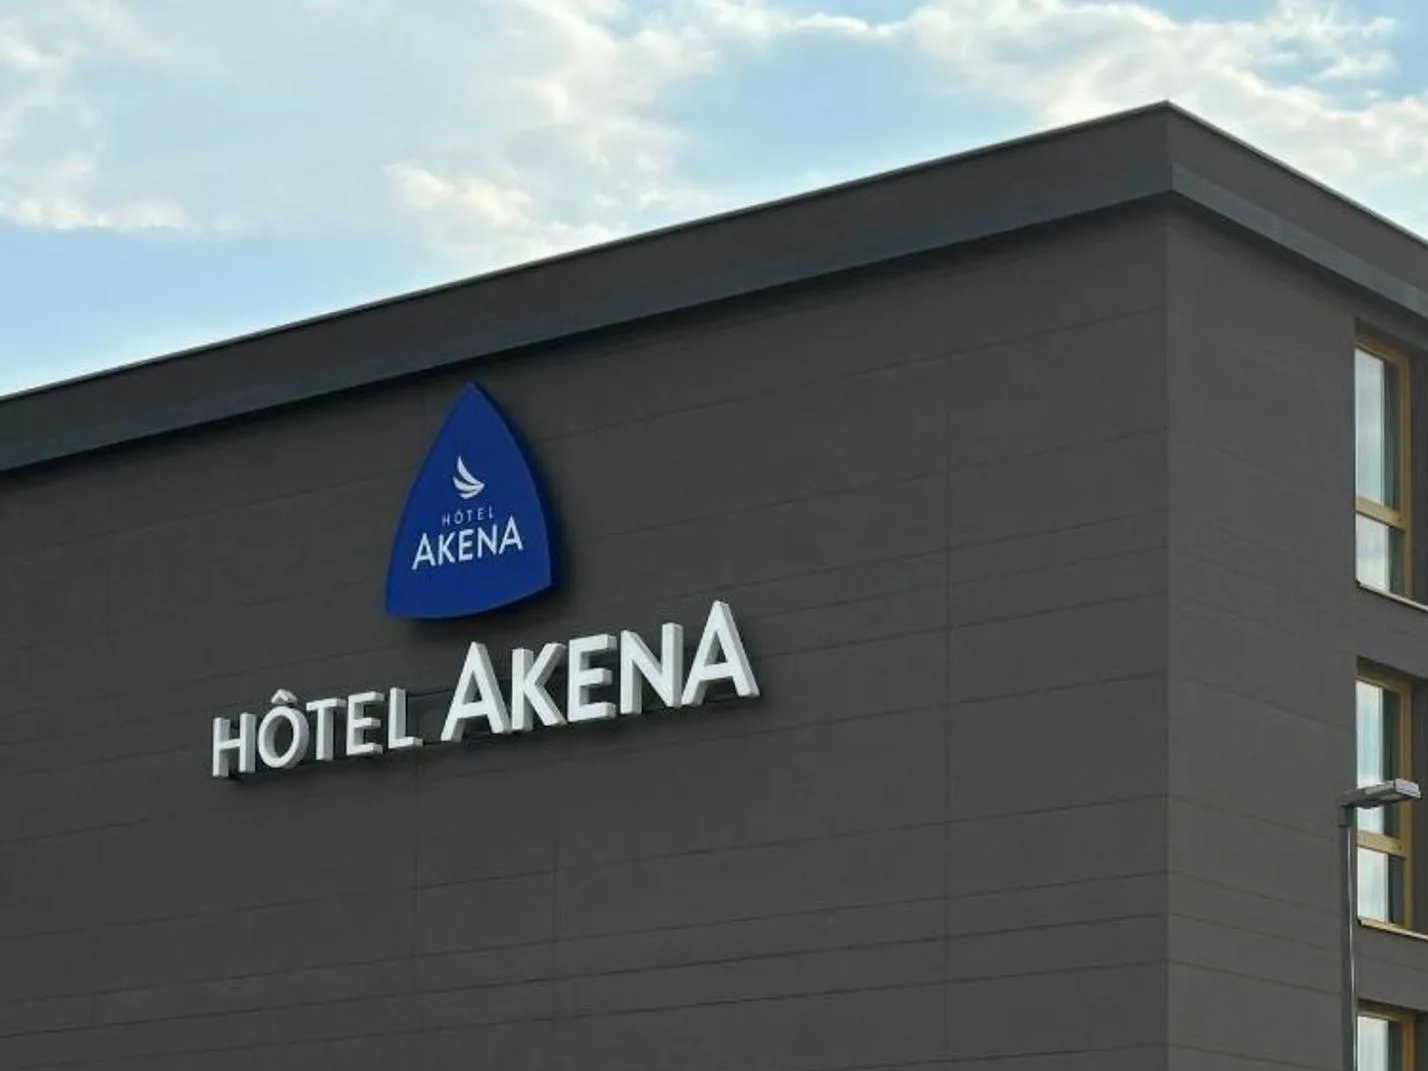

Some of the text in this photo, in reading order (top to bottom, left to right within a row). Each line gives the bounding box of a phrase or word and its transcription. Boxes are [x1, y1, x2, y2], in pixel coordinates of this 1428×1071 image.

[411, 515, 524, 571] AKENA
[442, 505, 493, 526] HÔTEL
[212, 600, 760, 777] HÔTEL AKENA
